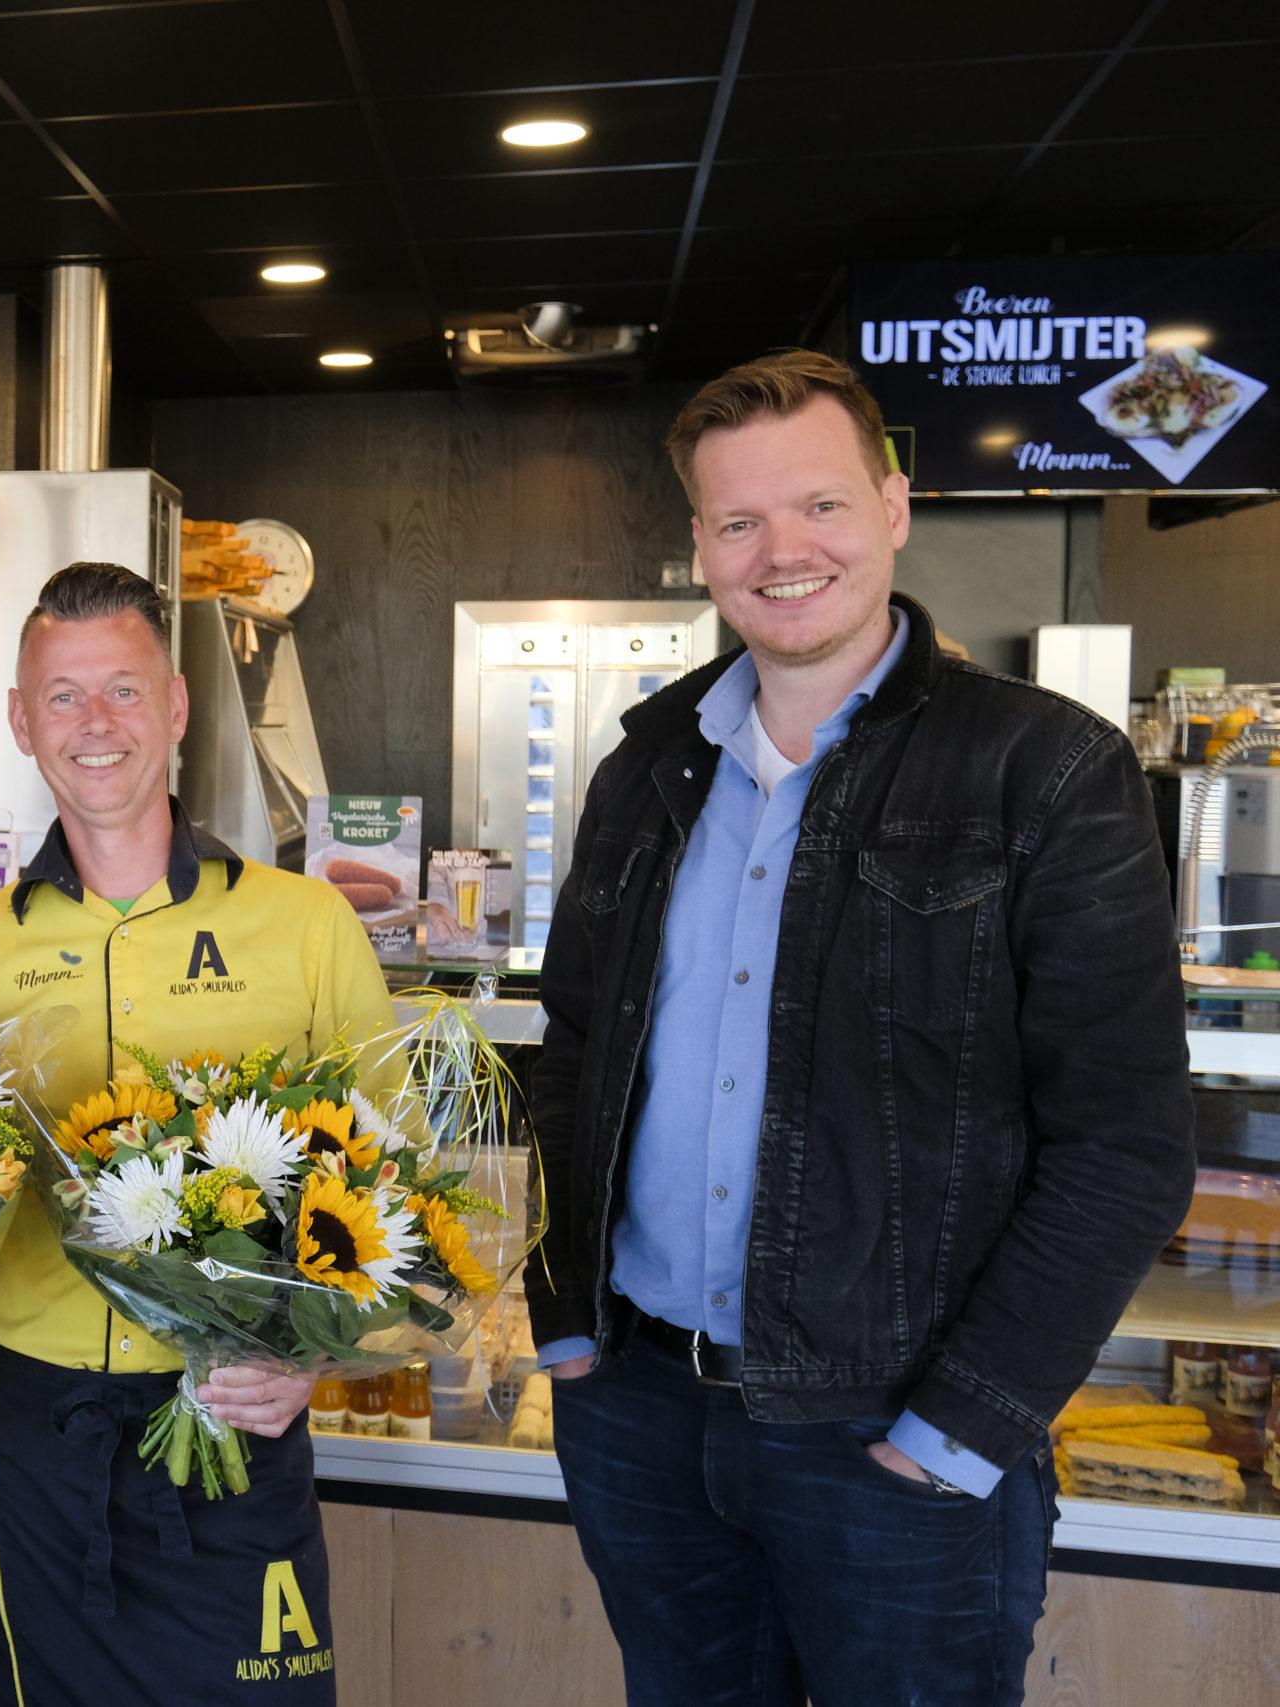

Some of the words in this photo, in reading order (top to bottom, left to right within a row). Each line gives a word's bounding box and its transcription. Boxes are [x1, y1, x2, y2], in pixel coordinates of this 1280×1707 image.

[954, 286, 1054, 316] Boeren
[861, 316, 1147, 364] UITSMIJTER
[942, 366, 960, 386] DE
[965, 365, 1014, 386] STEVIGE
[1018, 364, 1061, 385] LUNCH
[348, 800, 382, 810] NIEUW
[342, 827, 389, 838] KROKET
[186, 930, 229, 979] A
[169, 982, 198, 995] ALIDA'S
[202, 980, 247, 994] SMULPALEIS
[261, 1560, 319, 1653] A
[236, 1657, 280, 1681] ALIDA'S
